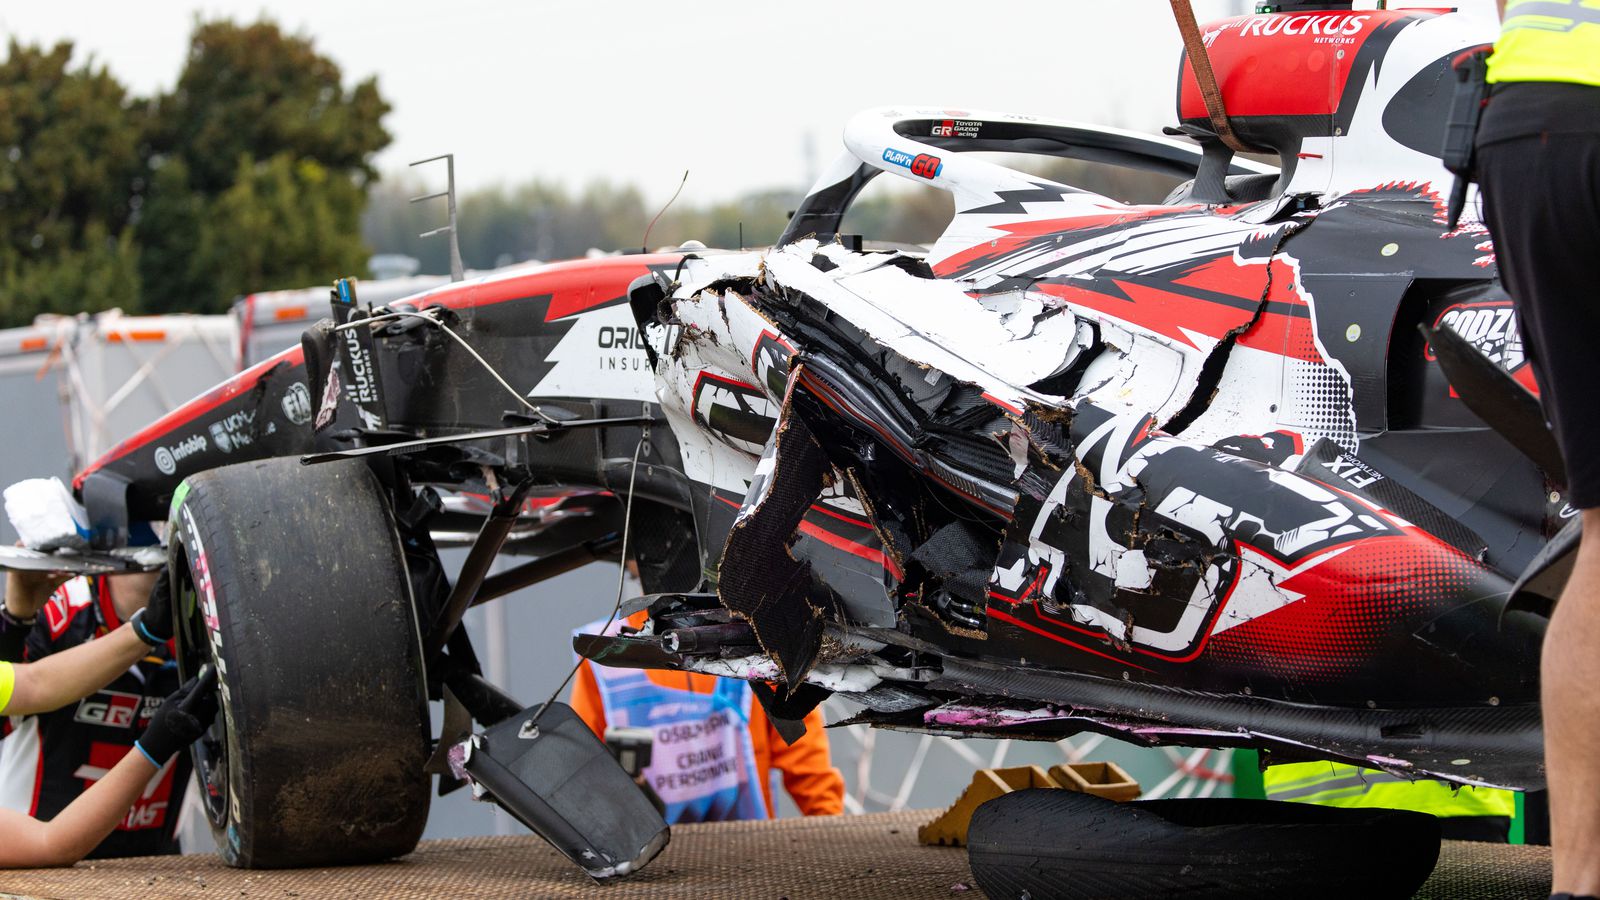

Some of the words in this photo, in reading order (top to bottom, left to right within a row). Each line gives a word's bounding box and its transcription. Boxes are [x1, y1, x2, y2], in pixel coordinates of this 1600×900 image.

[1240, 15, 1371, 37] RUCKUS
[931, 125, 953, 136] GR
[884, 150, 912, 167] PLAY'n
[912, 153, 941, 179] GO
[344, 328, 372, 402] RUCKUS
[363, 348, 378, 402] NETWORKS
[170, 433, 207, 462] infobip
[1320, 454, 1377, 489] FIX
[1340, 451, 1386, 480] NETWORK
[79, 702, 132, 726] GR
